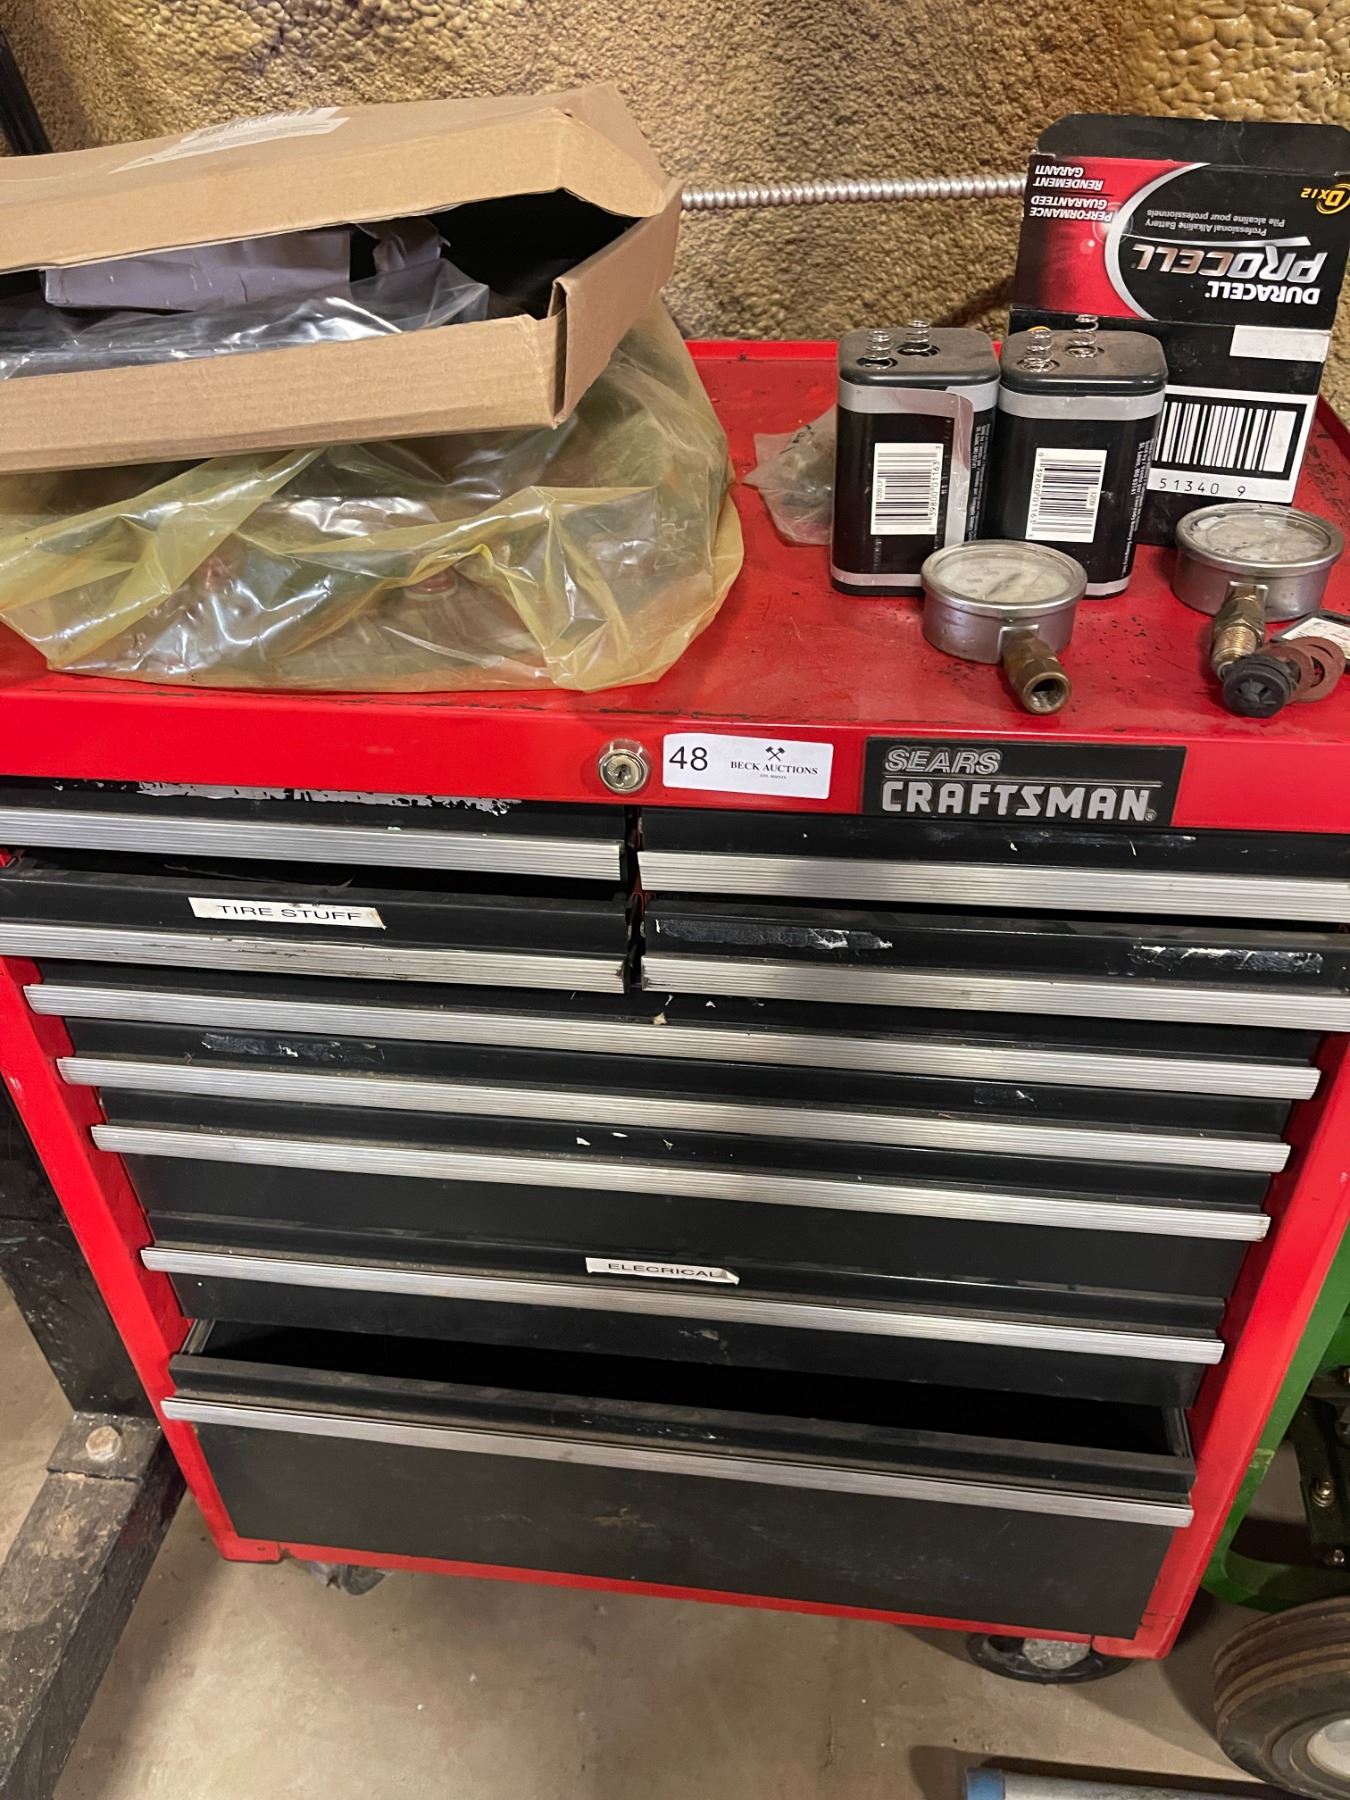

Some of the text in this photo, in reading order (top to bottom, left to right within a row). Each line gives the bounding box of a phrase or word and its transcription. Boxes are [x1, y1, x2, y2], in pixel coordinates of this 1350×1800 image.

[1035, 165, 1084, 178] GARANTI
[1032, 177, 1104, 191] RENDEMENT
[1030, 195, 1108, 210] GUARANTEED
[1029, 207, 1114, 223] PERFORMANCE
[1146, 209, 1286, 228] Pile alcaline pour professionnels
[1144, 217, 1268, 237] Professional Alkaline Battery
[1131, 243, 1329, 284] PROCELL
[1205, 280, 1321, 305] DURACELL
[1158, 477, 1246, 498] 51340 9
[668, 745, 709, 772] 48
[730, 760, 819, 775] BECK AUCTIONS
[883, 748, 1002, 776] SEARS
[881, 780, 1151, 822] CRAFTSMAN
[217, 904, 362, 921] TIRE STUFF
[607, 1262, 721, 1278] ELECRICAL
